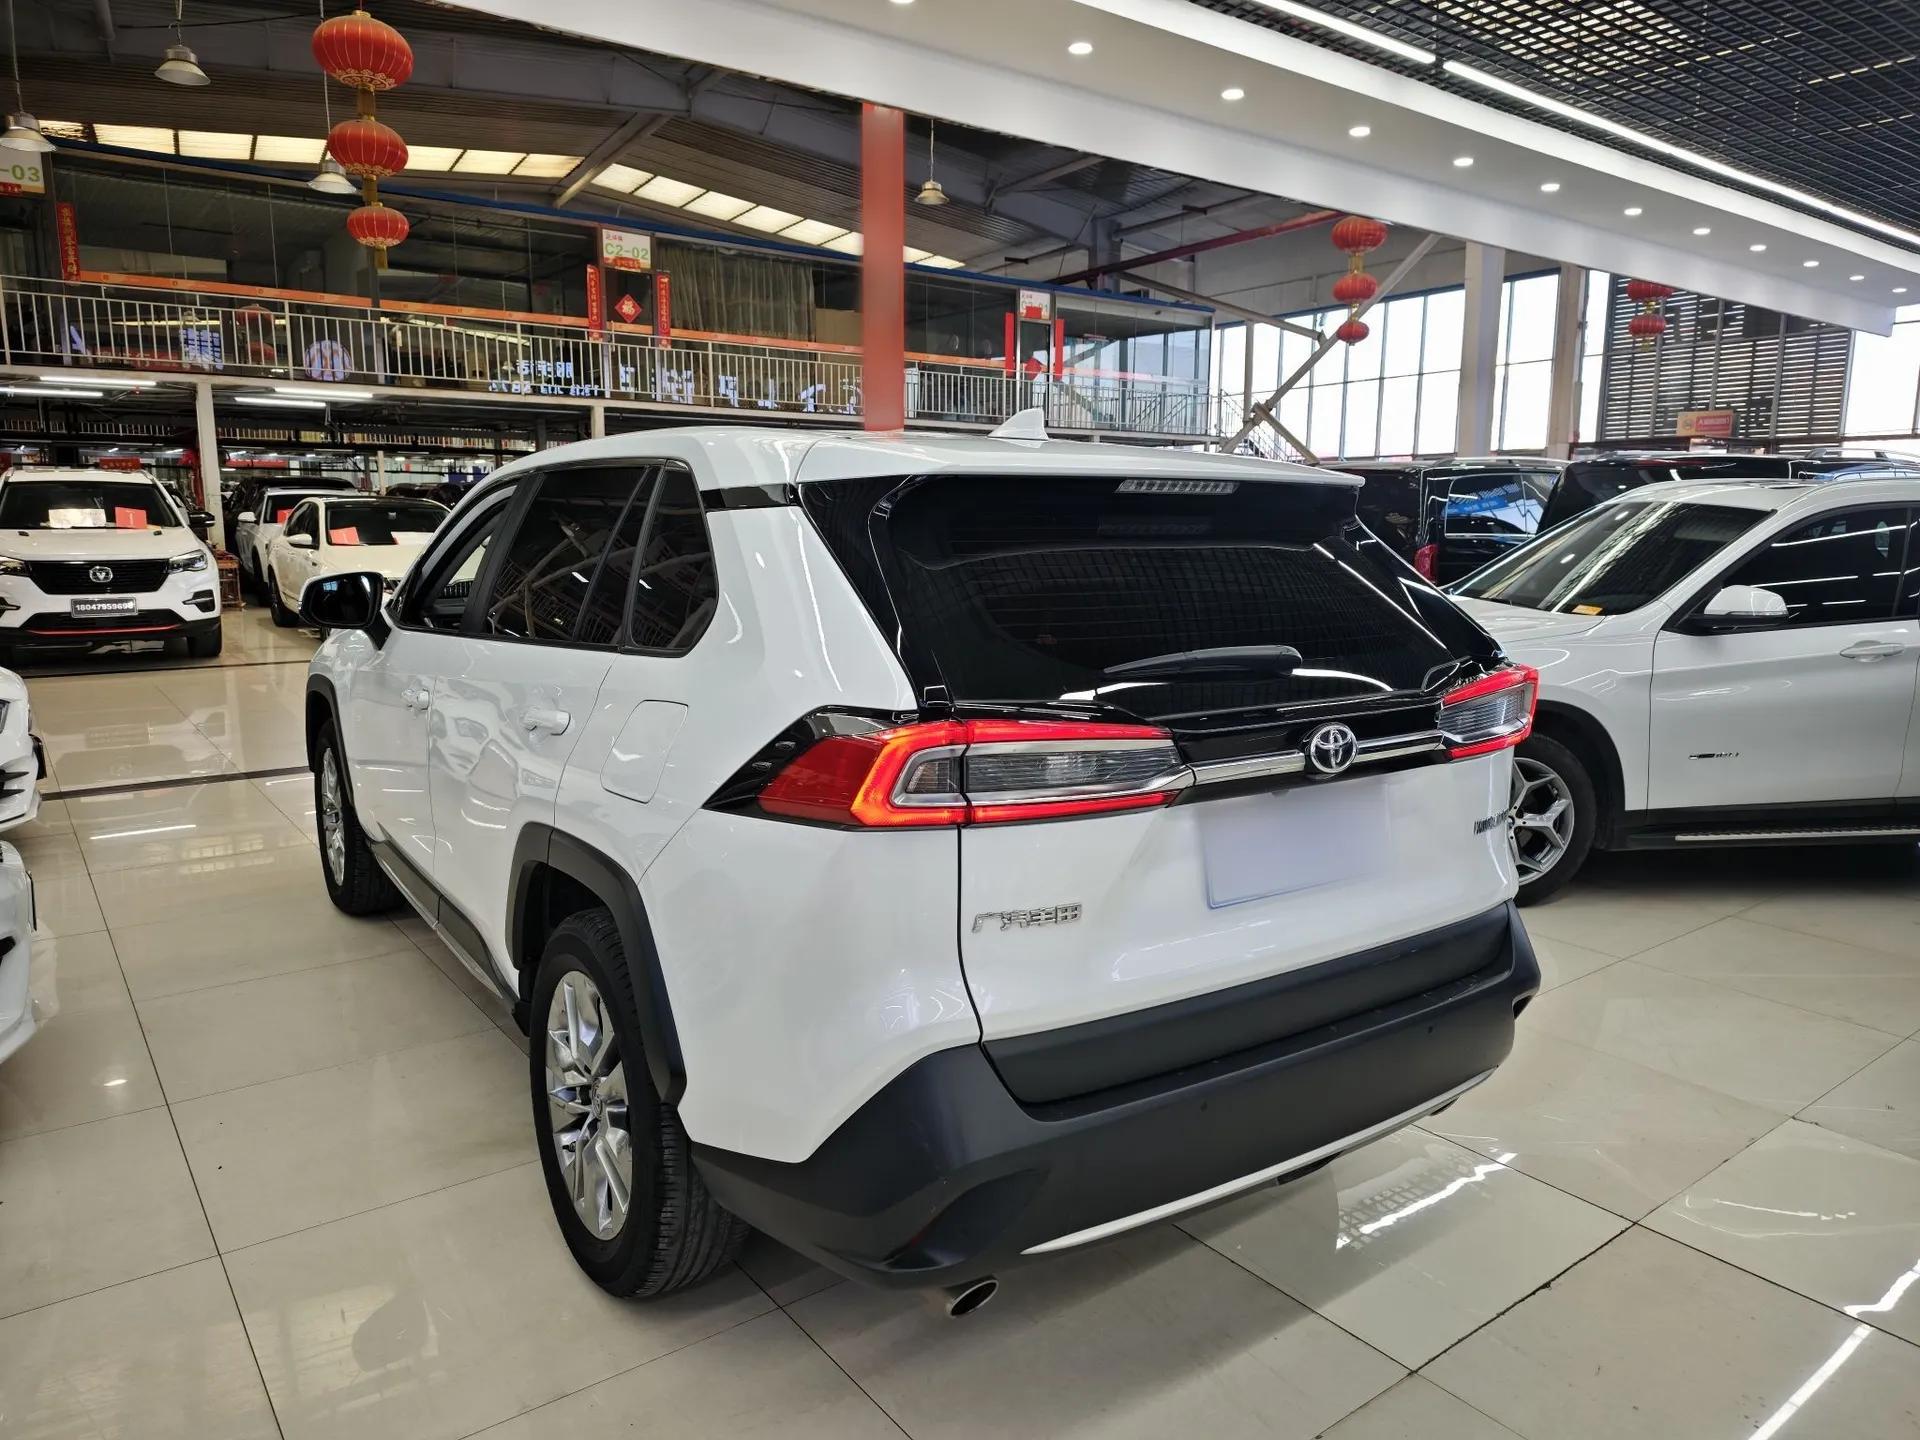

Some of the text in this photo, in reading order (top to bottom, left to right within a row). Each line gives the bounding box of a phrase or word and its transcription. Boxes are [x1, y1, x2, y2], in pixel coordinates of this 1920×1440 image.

[605, 242, 649, 261] C2-02
[972, 902, 1082, 933] 广汽丰田
